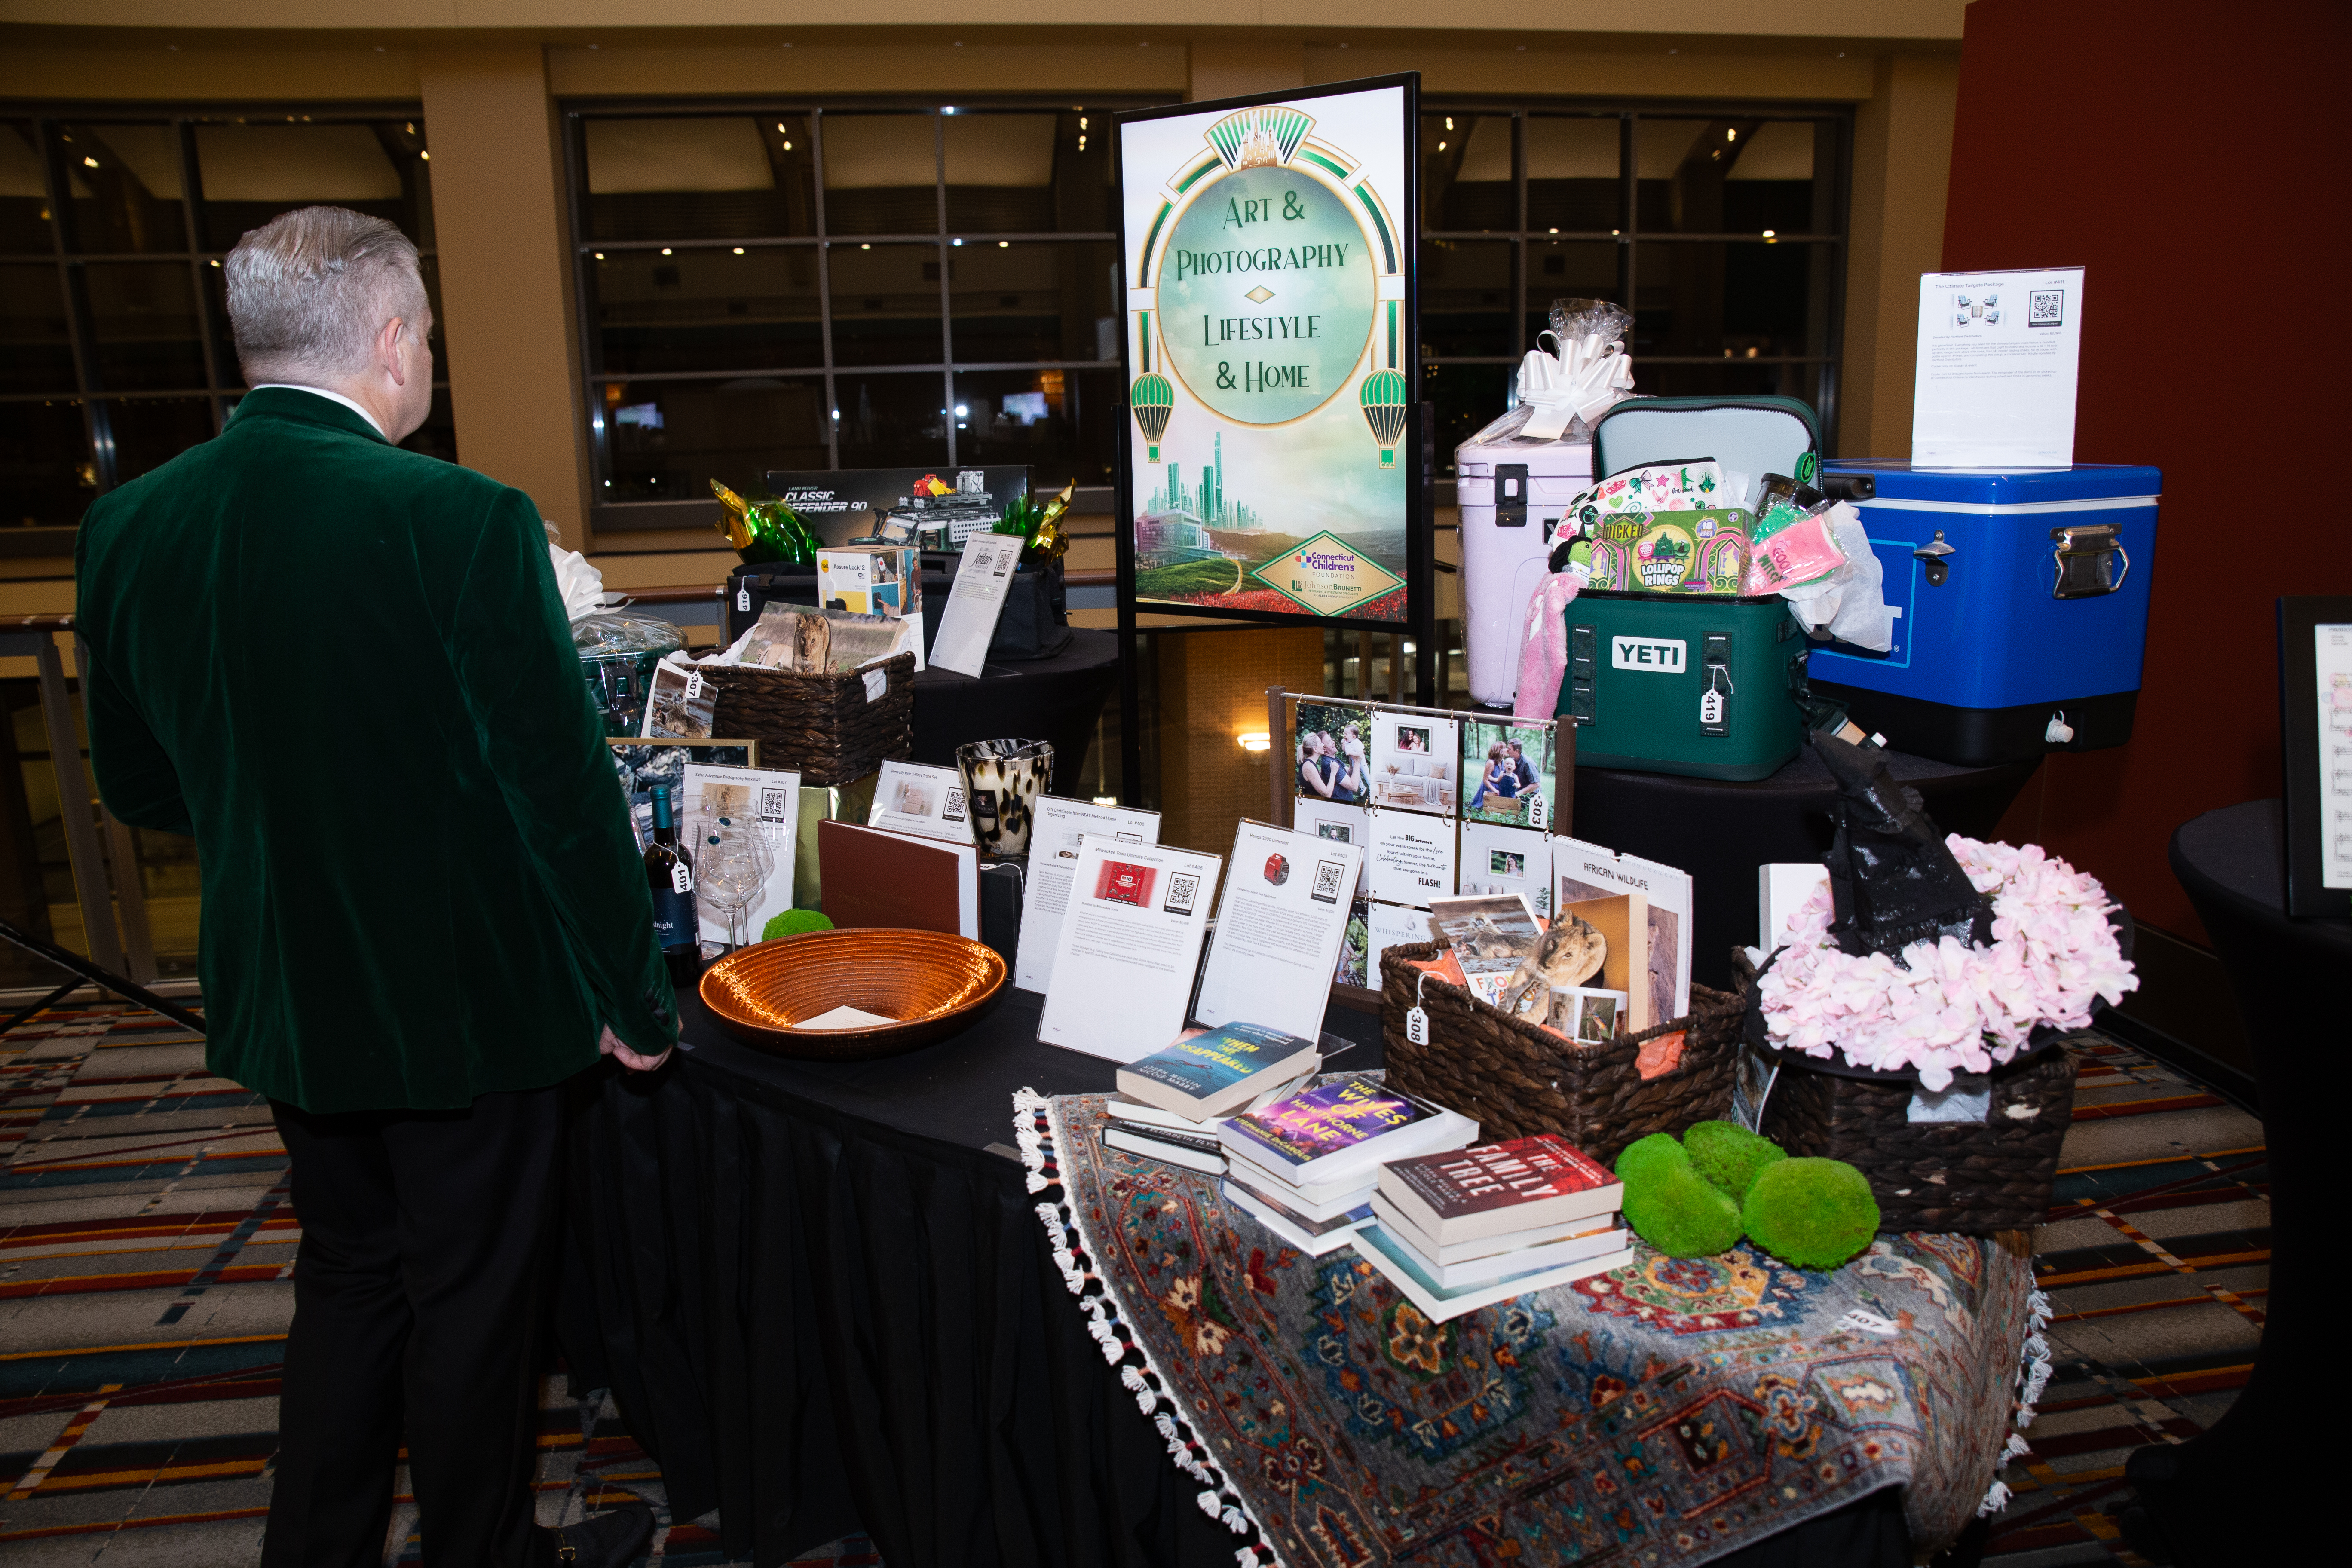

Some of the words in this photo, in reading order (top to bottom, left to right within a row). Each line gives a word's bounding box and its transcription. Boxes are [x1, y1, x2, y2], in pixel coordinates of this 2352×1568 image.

[1283, 191, 1305, 220] &
[1177, 244, 1349, 280] PHOTOGRAPHY
[1204, 315, 1320, 346] LIFESTYLE
[1216, 361, 1237, 389] &
[1246, 361, 1309, 392] HOME
[785, 491, 834, 502] CLASSIC
[851, 502, 867, 511] 90
[1602, 522, 1644, 541] WICKED
[1312, 552, 1354, 561] Connecticut
[1312, 560, 1354, 571] Children's
[1773, 547, 1794, 574] GOO
[1641, 563, 1685, 575] LOLLIPOP
[1644, 573, 1680, 587] RINGS
[1618, 643, 1678, 665] YETI
[689, 677, 698, 696] 307
[1705, 696, 1715, 720] 419
[1532, 799, 1542, 824] 303
[678, 869, 688, 891] 401
[1418, 877, 1440, 888] FLASH!
[1584, 862, 1614, 879] AFRICAN
[1616, 872, 1648, 890] WILDLIFE
[653, 921, 674, 930] dnight
[1375, 926, 1427, 942] WHISPERING
[1411, 1014, 1421, 1041] 308
[1349, 1081, 1376, 1095] THE
[1331, 1104, 1367, 1119] OF
[1338, 1089, 1408, 1126] WIVES
[1234, 1117, 1273, 1139] STEPHANIE
[1280, 1109, 1341, 1142] LANE
[1290, 1099, 1369, 1140] HAWTHORNE
[1196, 1139, 1218, 1147] FLYN
[1465, 1144, 1559, 1197] FAMILY
[1527, 1153, 1564, 1172] THE
[1440, 1159, 1505, 1197] TREE
